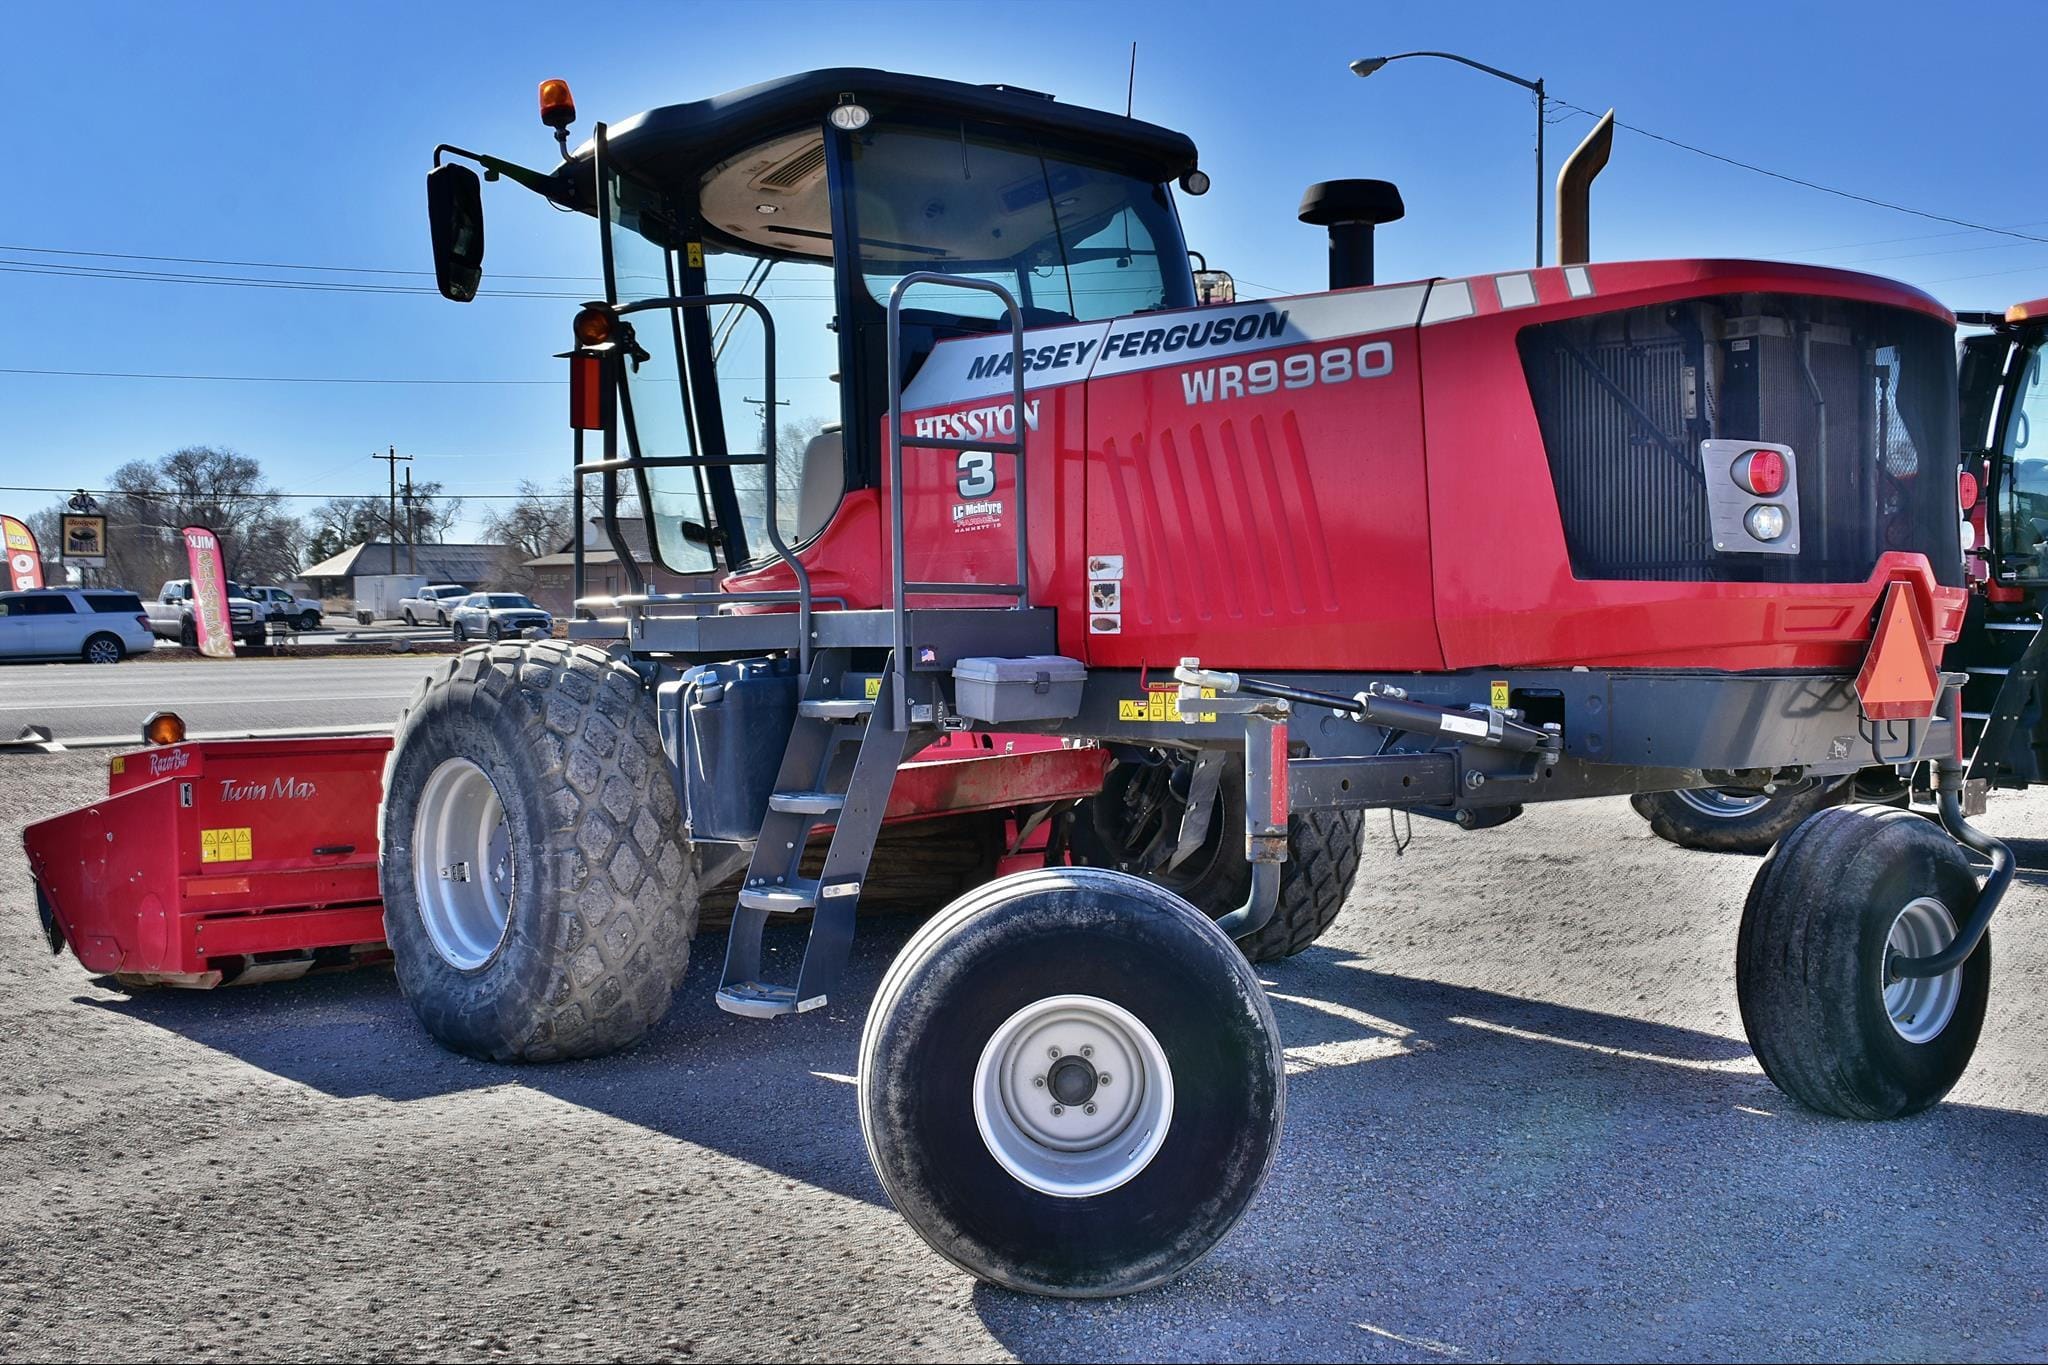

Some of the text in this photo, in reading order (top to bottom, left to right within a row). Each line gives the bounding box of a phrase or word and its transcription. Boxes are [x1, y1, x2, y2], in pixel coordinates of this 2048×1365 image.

[967, 310, 1289, 380] MASSEY FERGUSON
[1181, 341, 1394, 405] WR9980
[914, 399, 1040, 440] HESSTON
[957, 450, 996, 500] 3
[953, 502, 1001, 521] LC McIntyre
[219, 779, 268, 802] Twin
